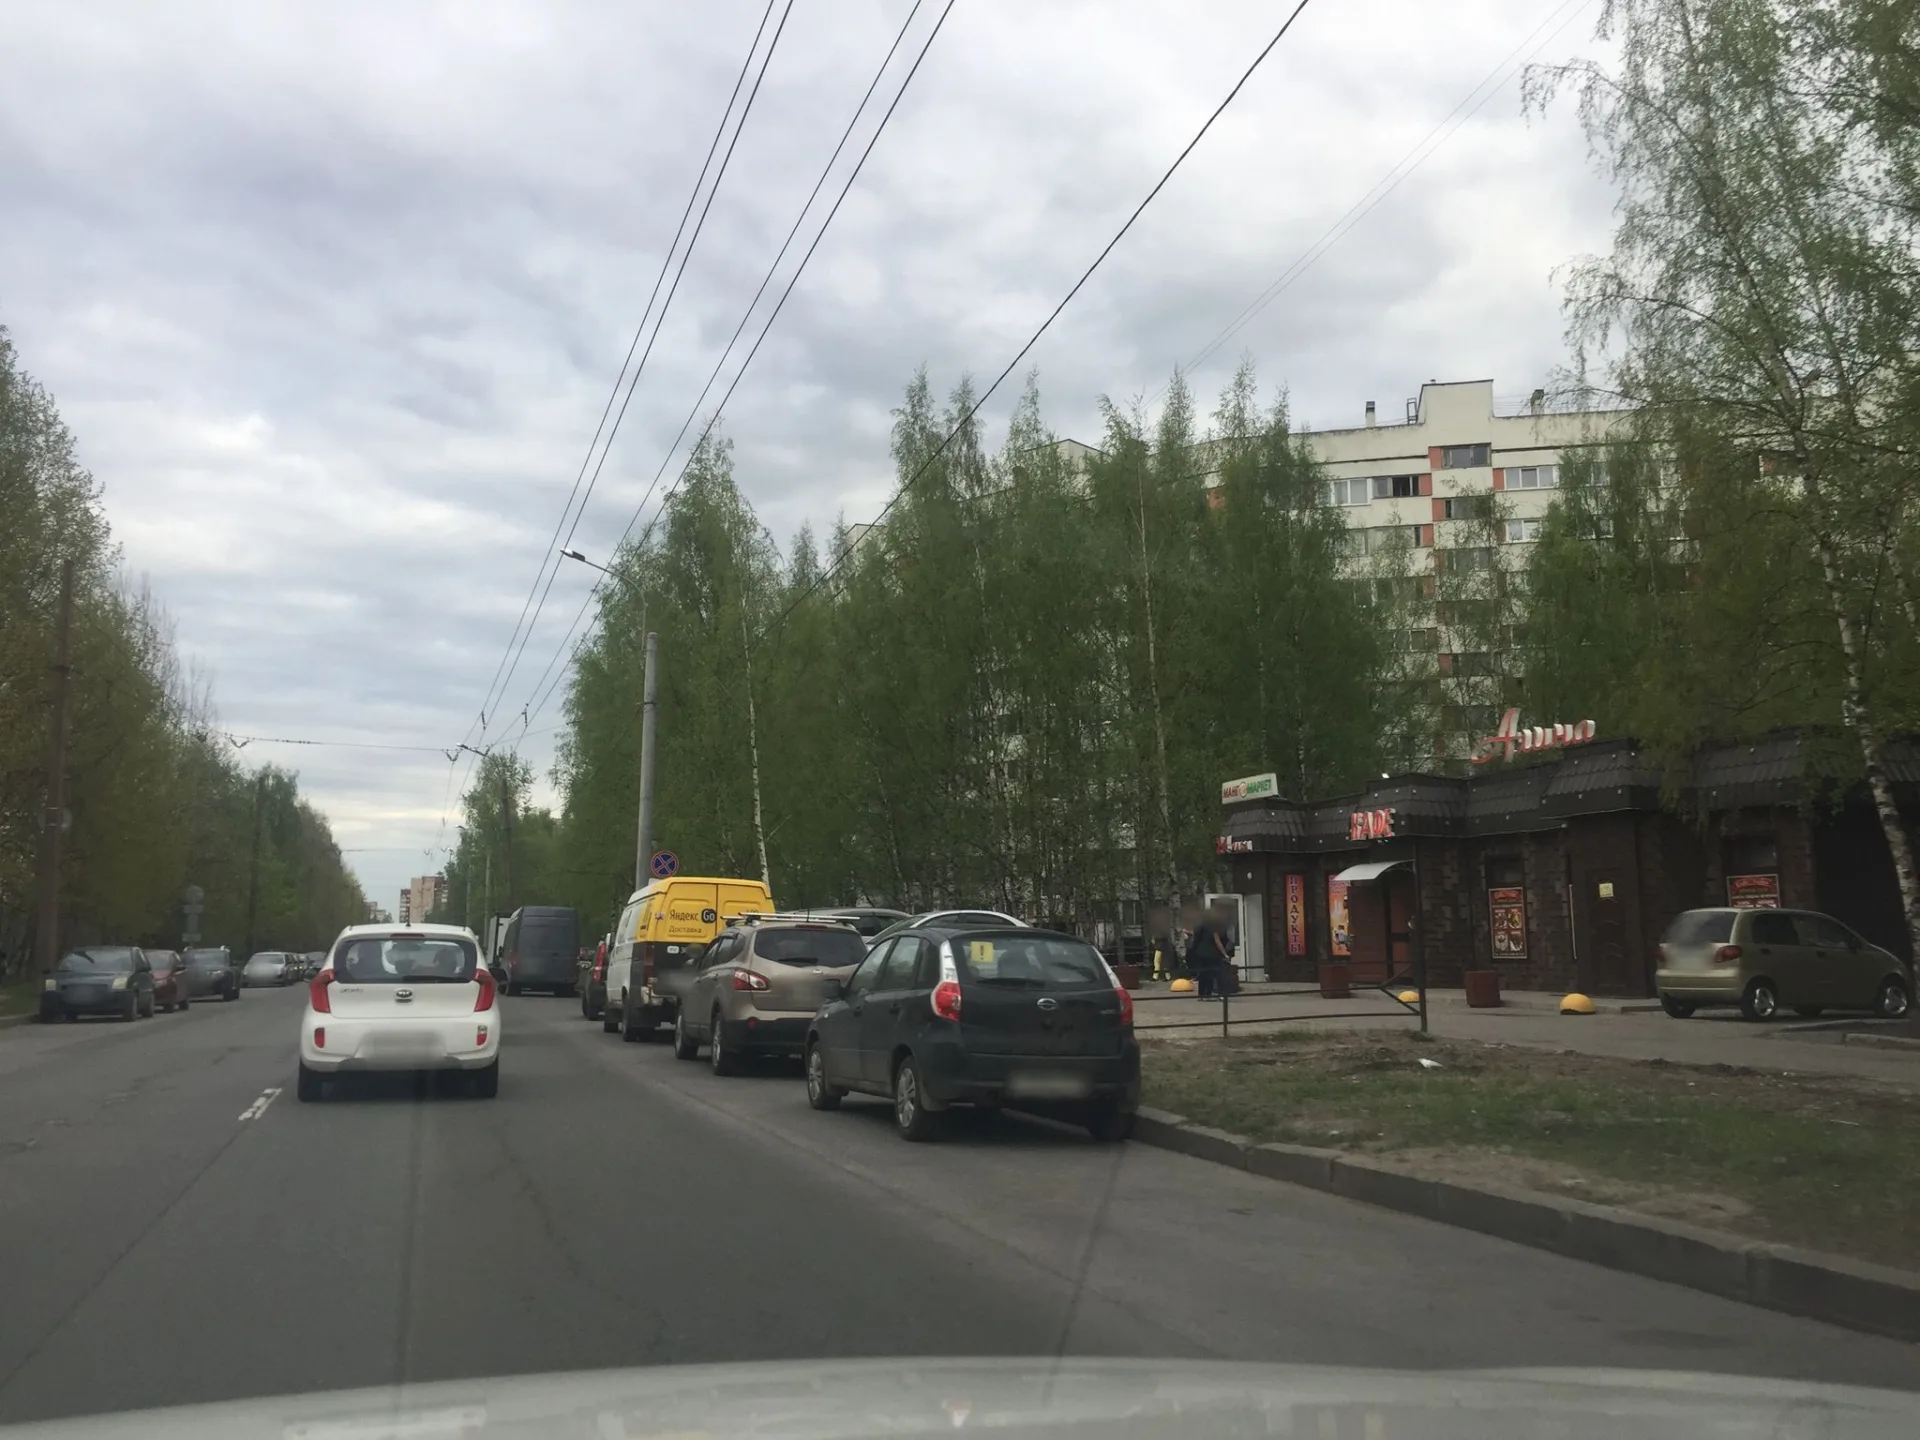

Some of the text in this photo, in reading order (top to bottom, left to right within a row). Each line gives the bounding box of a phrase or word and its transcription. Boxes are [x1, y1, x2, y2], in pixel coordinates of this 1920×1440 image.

[1350, 808, 1396, 840] КАФЕ
[669, 909, 716, 922] Яндекс Go
[1290, 876, 1301, 952] ПРОДУКТЫ
[669, 925, 702, 933] Доставка
